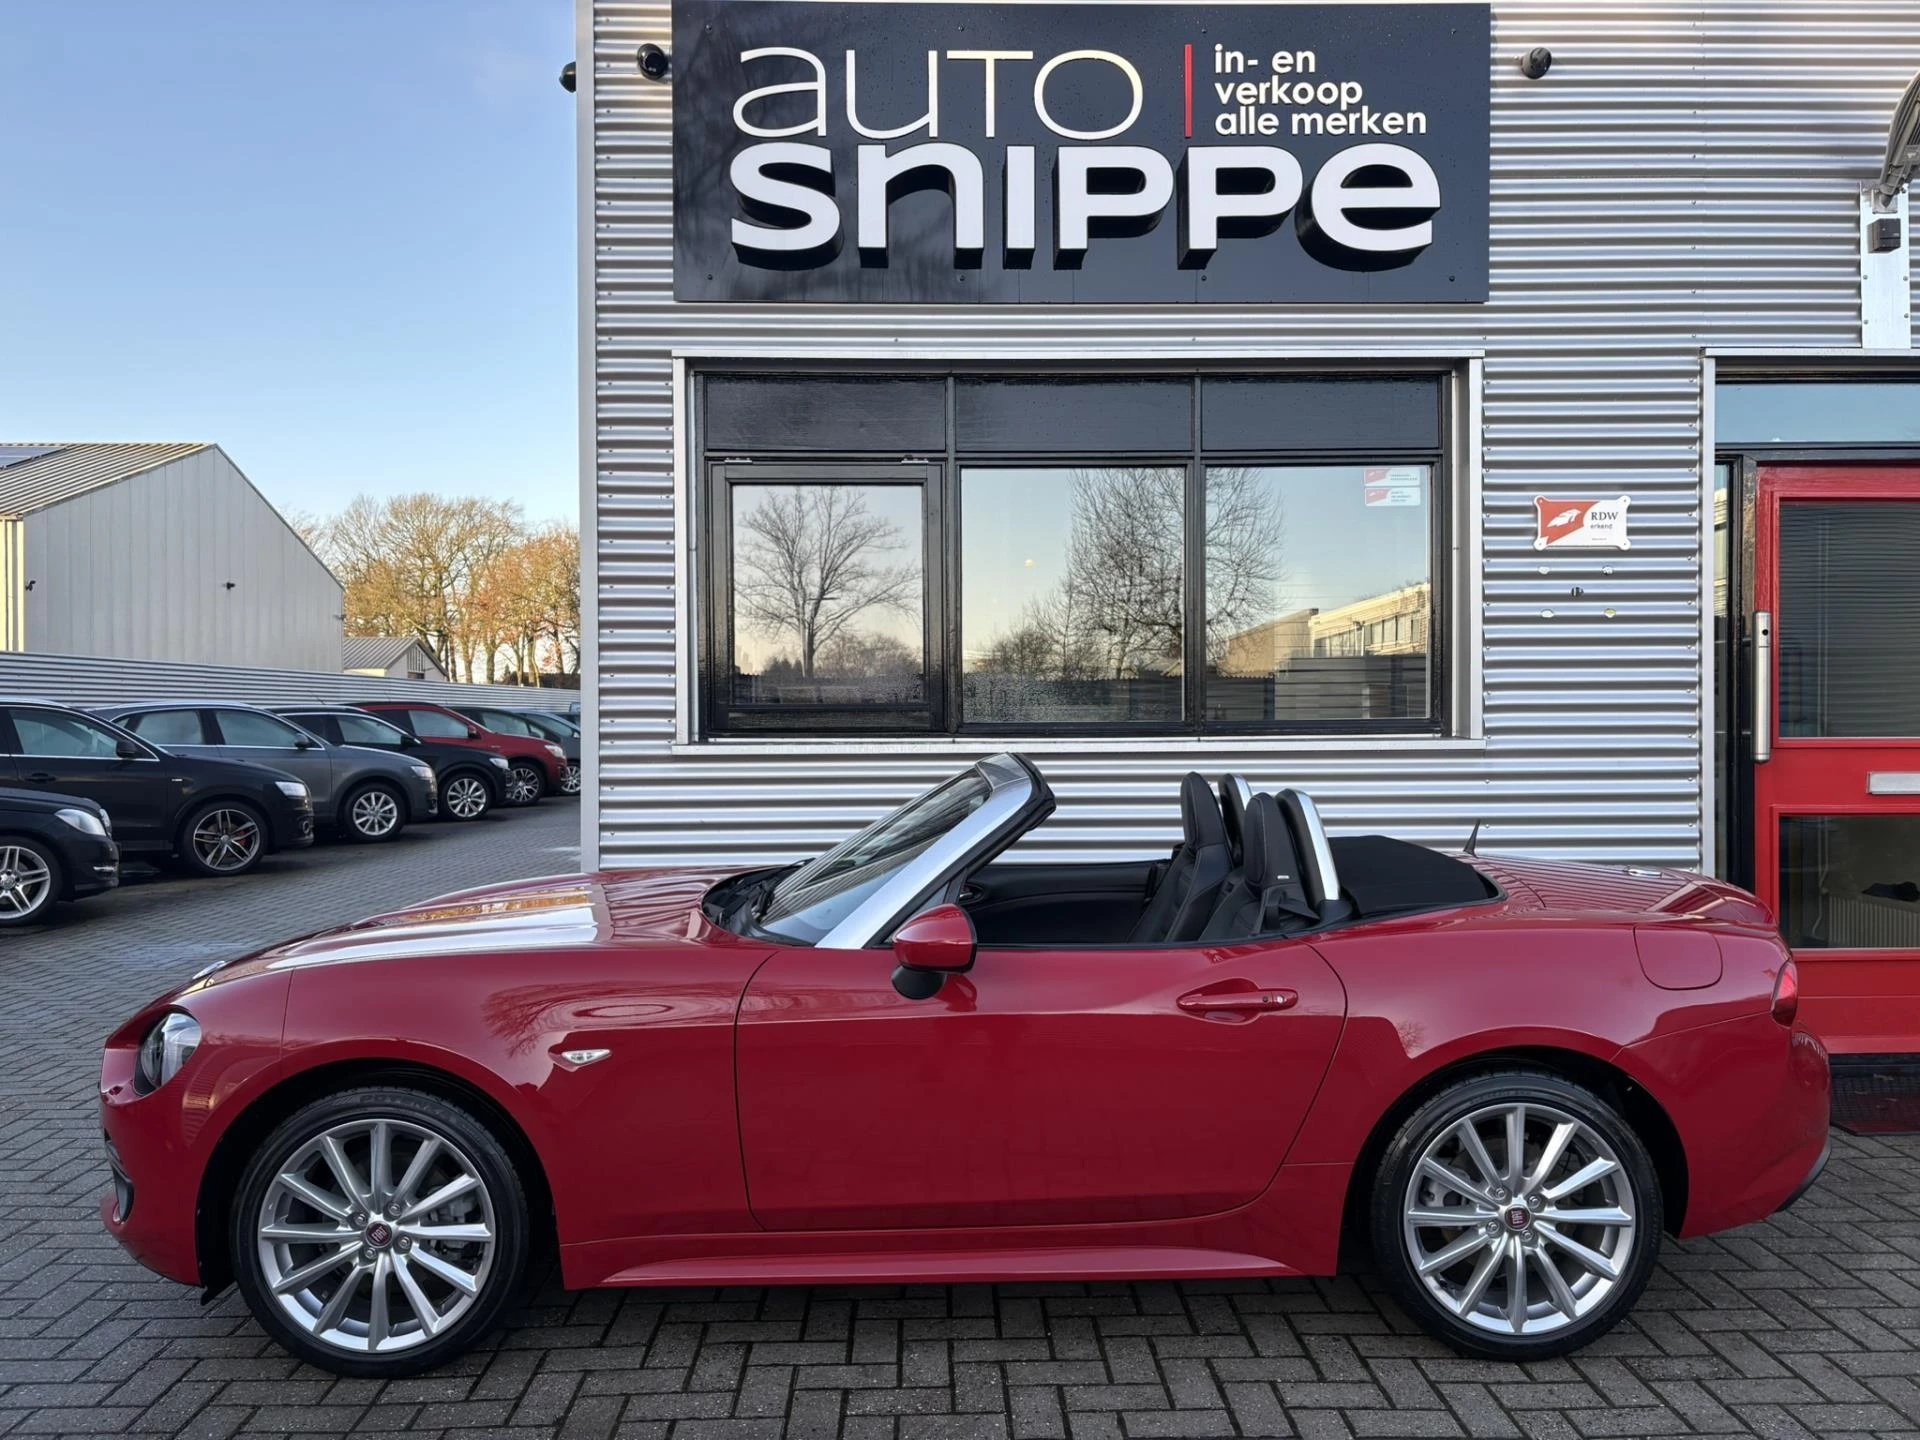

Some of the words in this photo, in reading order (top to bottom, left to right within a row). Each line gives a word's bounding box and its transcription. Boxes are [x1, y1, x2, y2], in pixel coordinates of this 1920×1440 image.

[1214, 43, 1259, 73] in-
[1271, 50, 1316, 73] en
[1214, 75, 1363, 111] verkoop
[1215, 105, 1280, 135] alle
[1291, 105, 1427, 135] merken
[1591, 511, 1619, 521] RDW
[371, 1225, 388, 1243] FIAT
